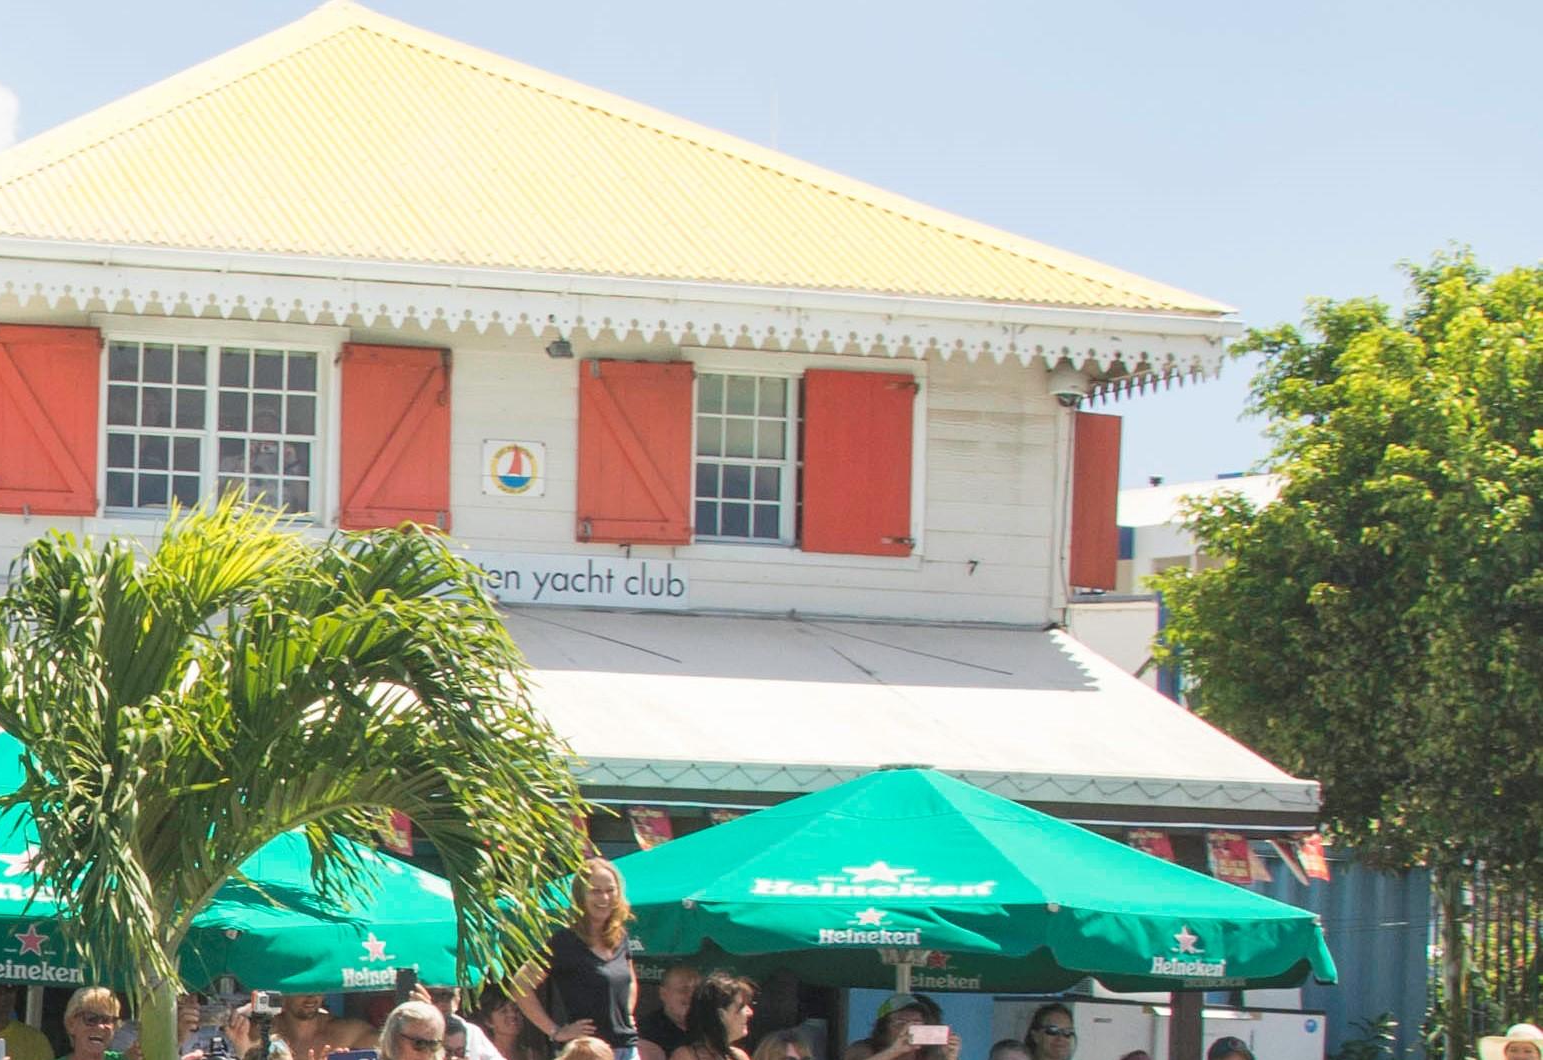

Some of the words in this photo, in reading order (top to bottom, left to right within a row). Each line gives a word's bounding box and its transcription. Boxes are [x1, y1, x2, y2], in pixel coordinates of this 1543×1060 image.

[532, 559, 614, 600] yacht
[625, 561, 685, 598] club
[748, 877, 998, 898] Heineken
[817, 927, 919, 946] Heineken
[1149, 956, 1226, 977] Heineken
[910, 971, 981, 990] eineken
